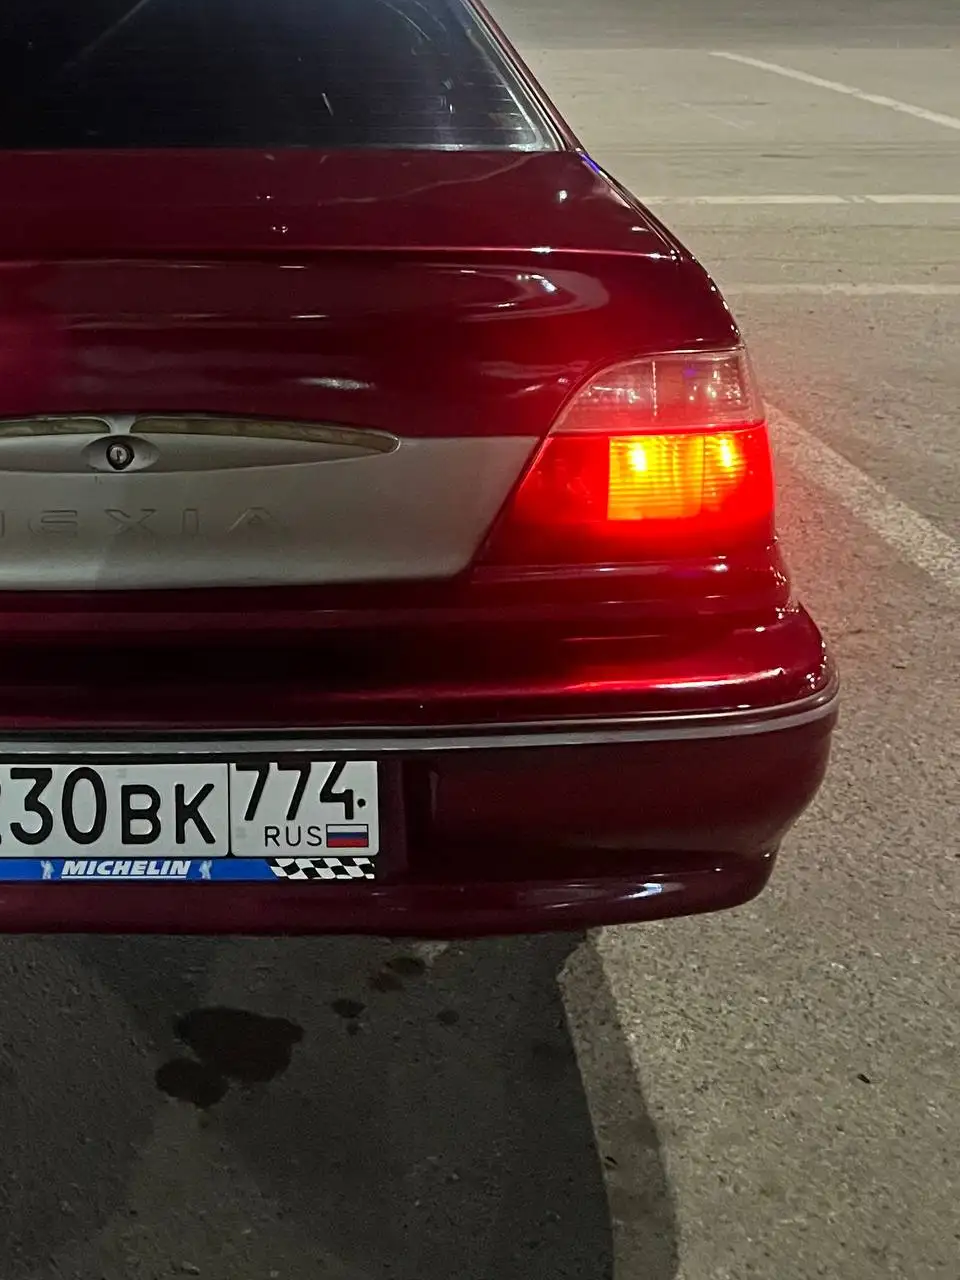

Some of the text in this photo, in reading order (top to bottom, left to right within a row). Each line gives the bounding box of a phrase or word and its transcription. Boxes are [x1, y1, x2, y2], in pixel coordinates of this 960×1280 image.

[235, 762, 355, 821] 774
[263, 825, 323, 848] RUS
[61, 859, 192, 877] MICHELIN
